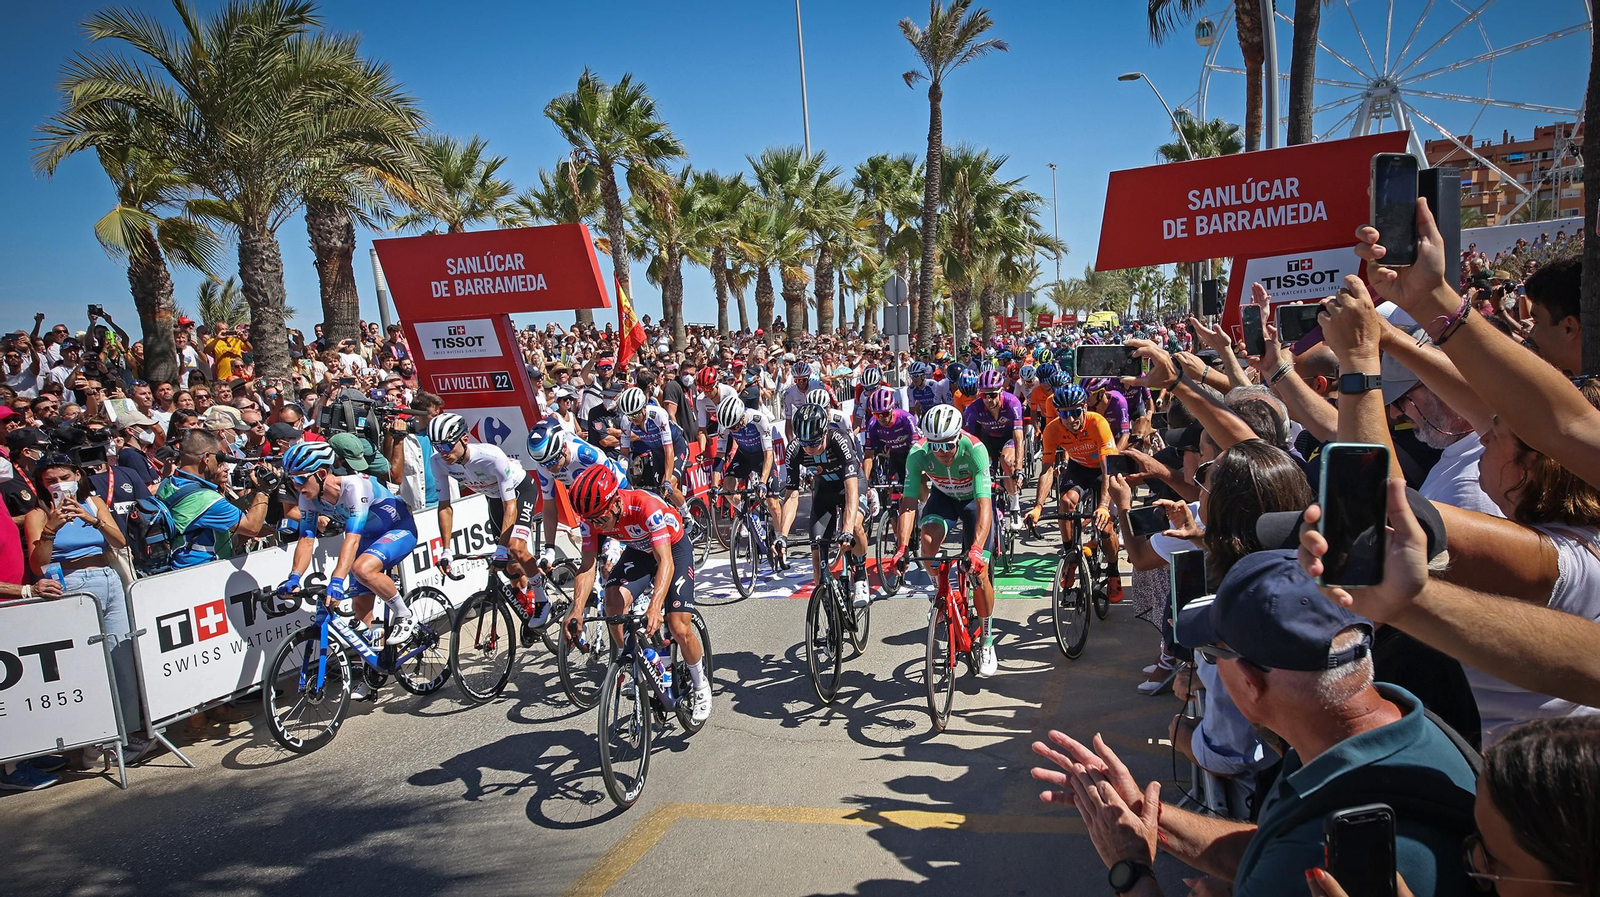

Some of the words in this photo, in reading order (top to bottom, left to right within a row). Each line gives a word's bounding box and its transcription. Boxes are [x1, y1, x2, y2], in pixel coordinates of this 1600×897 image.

[1187, 177, 1299, 211] SANLÚCAR
[1163, 217, 1188, 240] DE
[1196, 200, 1328, 236] BARRAMEDA
[446, 251, 525, 275] SANLÚCAR
[431, 280, 451, 298] DE
[454, 273, 548, 296] BARRAMEDA
[1261, 269, 1340, 290] TISSOT
[432, 335, 485, 349] TISSOT
[438, 378, 451, 391] LA
[451, 376, 490, 390] VUELTA
[495, 374, 509, 388] 22
[520, 501, 534, 523] UAE
[450, 520, 495, 556] TISS
[502, 585, 529, 620] COLNAGO
[163, 647, 222, 677] SWISS
[229, 620, 302, 654] WATCHES
[332, 618, 378, 658] GIANT
[25, 688, 84, 711] 1853
